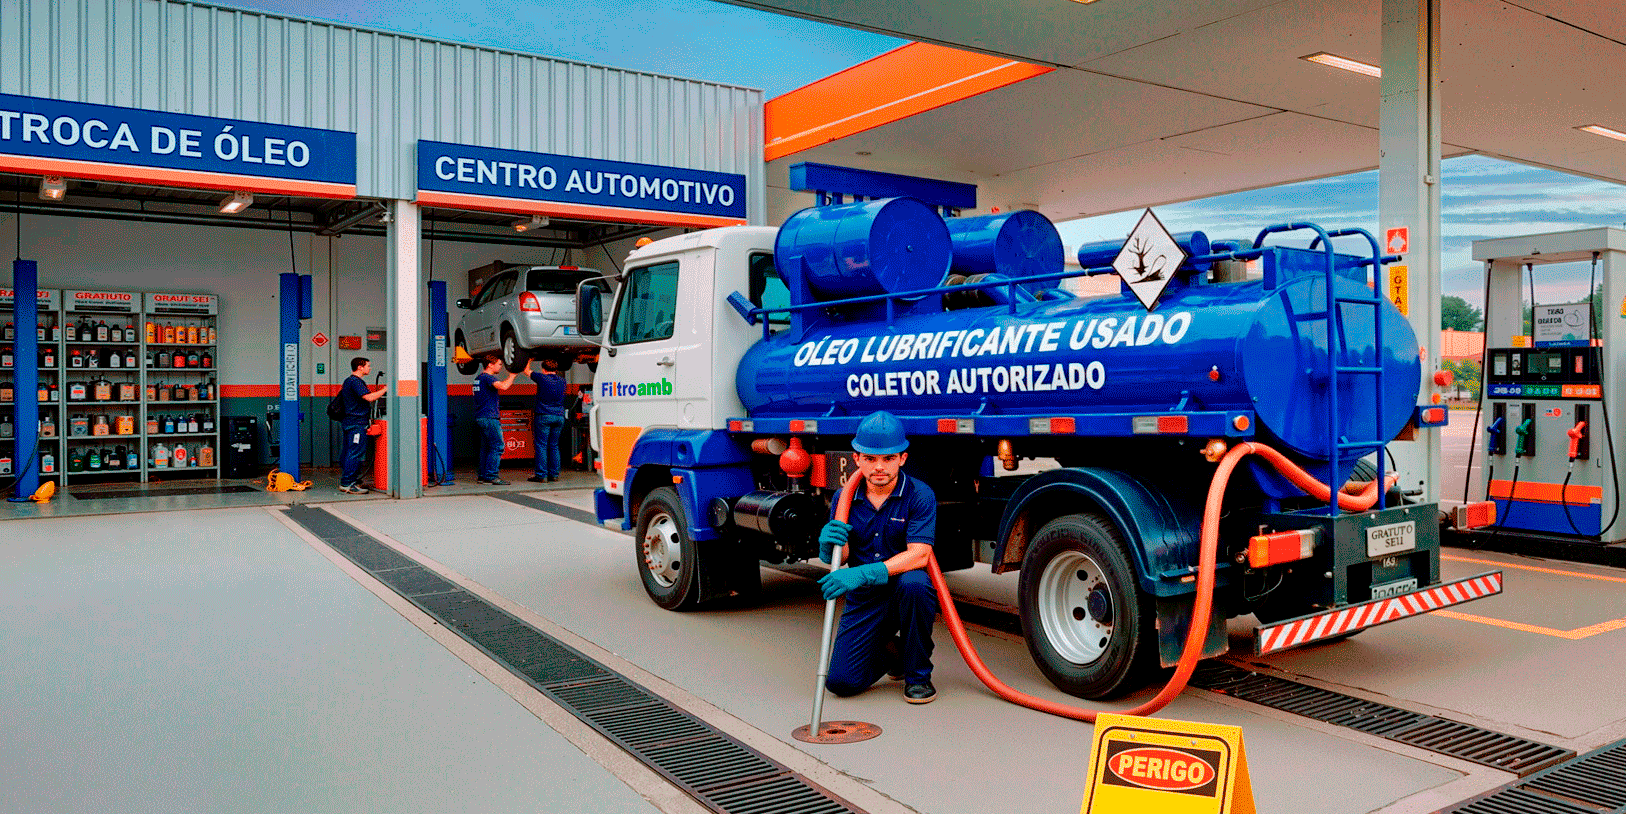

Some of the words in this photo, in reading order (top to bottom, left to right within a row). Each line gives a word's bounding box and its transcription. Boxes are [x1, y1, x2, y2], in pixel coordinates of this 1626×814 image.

[0, 109, 140, 152] TROCA
[150, 125, 202, 158] DE
[213, 125, 310, 168] ÓLEO
[434, 155, 558, 190] CENTRO
[564, 169, 735, 206] AUTOMOTIVO
[793, 335, 860, 367] ÓLEO
[860, 320, 1067, 364] LUBRIFICANTE
[1068, 311, 1193, 352] USADO
[601, 377, 673, 398] Filtroamb
[845, 369, 942, 398] COLETOR
[946, 360, 1106, 395] AUTORIZADO
[1118, 754, 1206, 784] PERIGO
